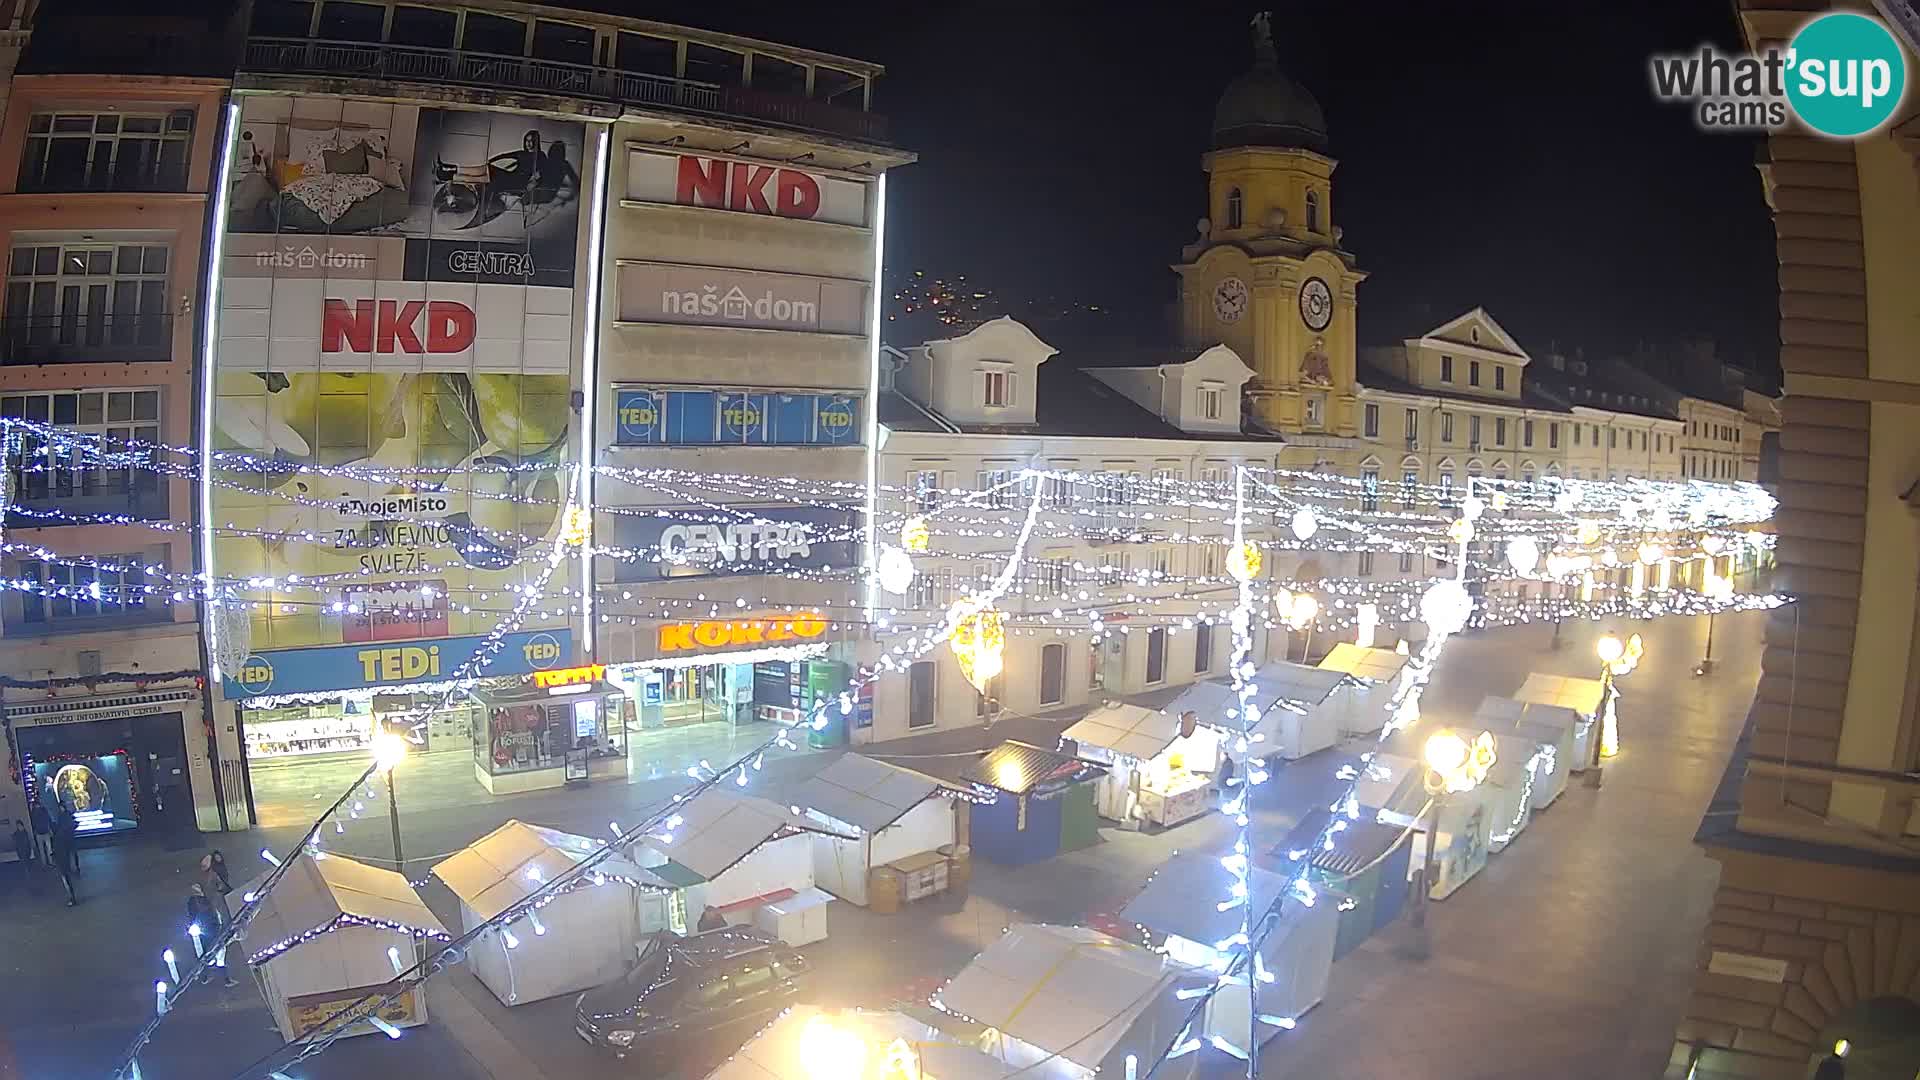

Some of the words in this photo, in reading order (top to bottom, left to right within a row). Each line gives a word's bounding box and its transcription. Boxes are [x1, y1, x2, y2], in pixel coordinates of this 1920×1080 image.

[676, 154, 821, 221] NKD
[255, 246, 296, 268] naš
[320, 249, 367, 270] dom
[449, 249, 535, 276] CENTRA
[662, 284, 717, 317] naš
[754, 290, 817, 323] dom
[321, 298, 476, 353] NKD
[619, 408, 658, 425] TEDi
[724, 409, 760, 426] TEDi
[334, 529, 357, 549] ZA
[367, 525, 450, 548] DNEVNO
[660, 522, 810, 564] CENTRA
[658, 612, 826, 651] KORZO
[358, 646, 440, 682] TEDi
[524, 644, 560, 660] TEDi
[237, 666, 273, 684] TEDi
